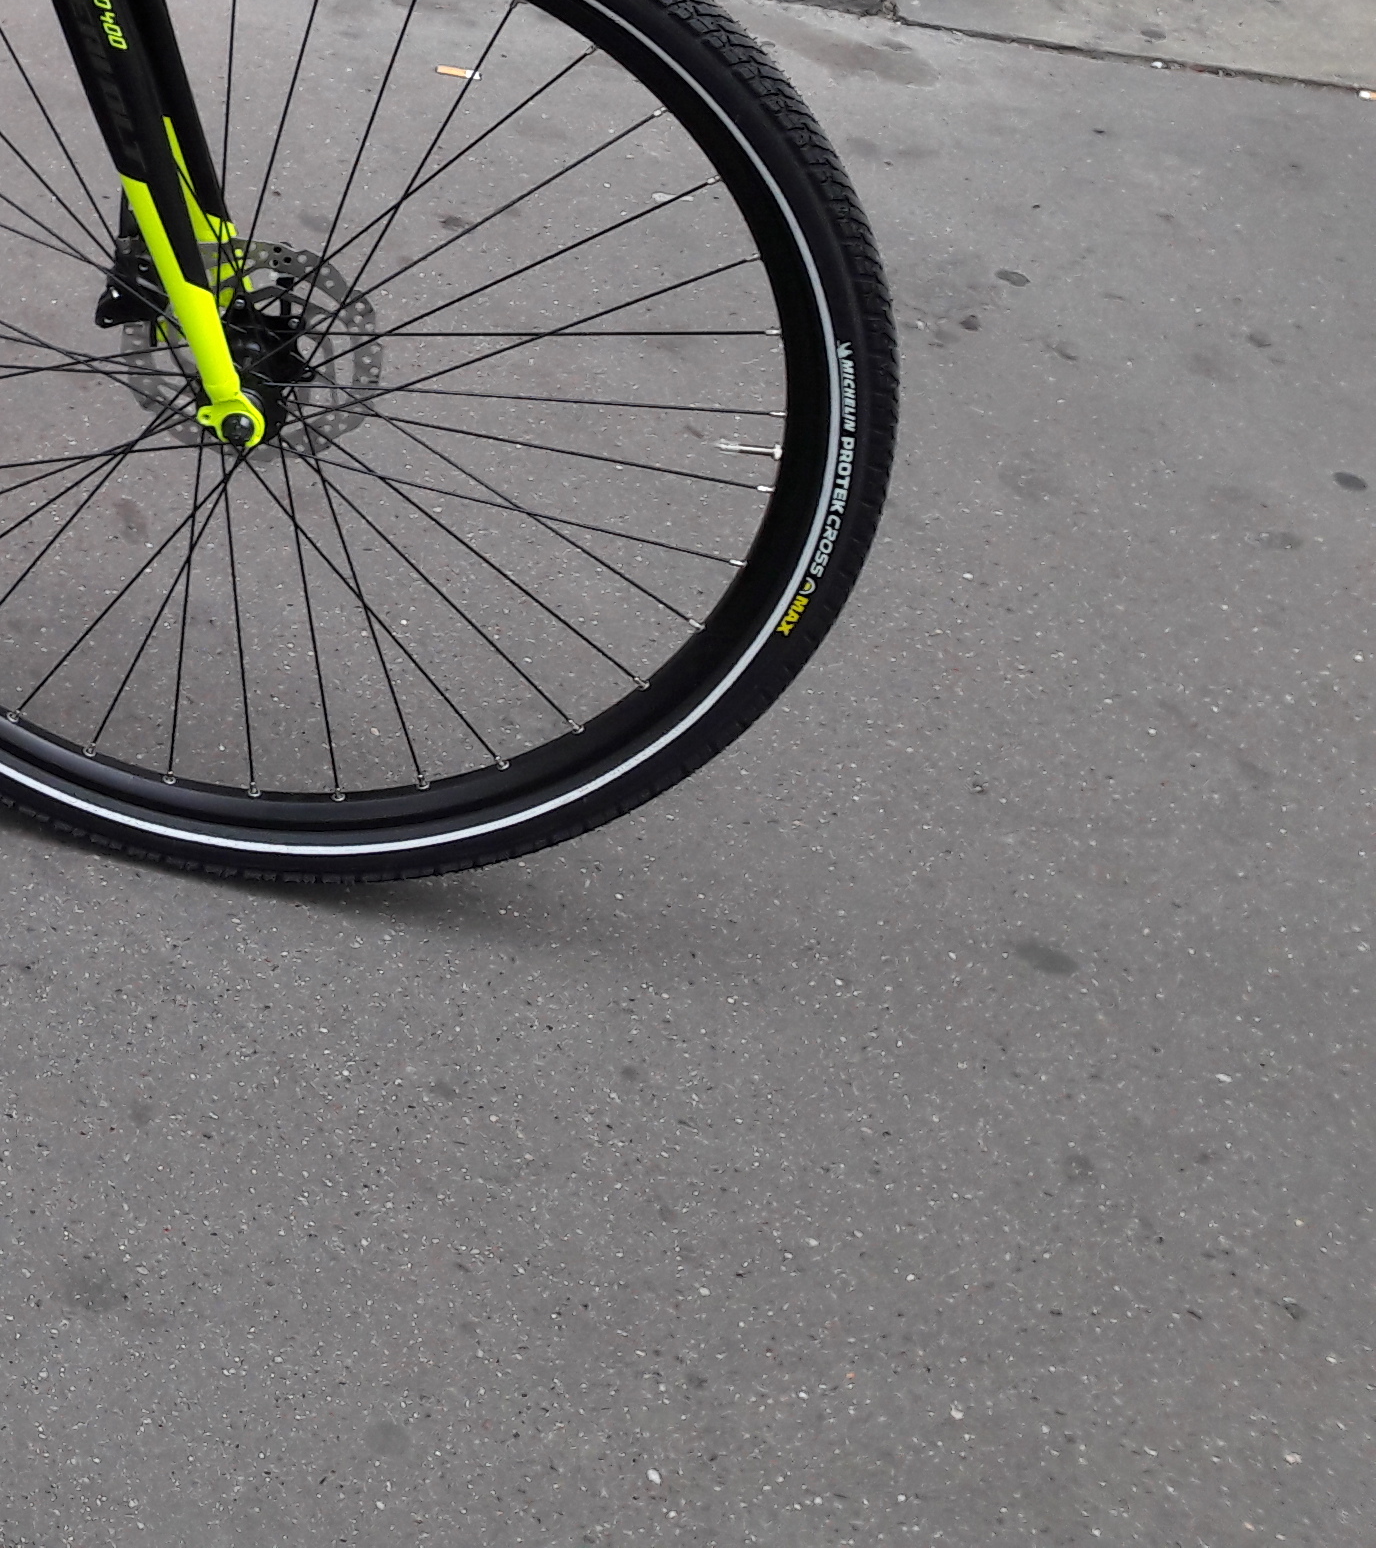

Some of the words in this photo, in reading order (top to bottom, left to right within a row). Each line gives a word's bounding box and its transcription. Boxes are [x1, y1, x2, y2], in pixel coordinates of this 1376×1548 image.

[100, 12, 128, 50] 400
[840, 357, 856, 433] MICHELIN
[829, 436, 856, 514] PROTEK
[810, 514, 841, 578] CROSS
[776, 595, 810, 637] MAX
